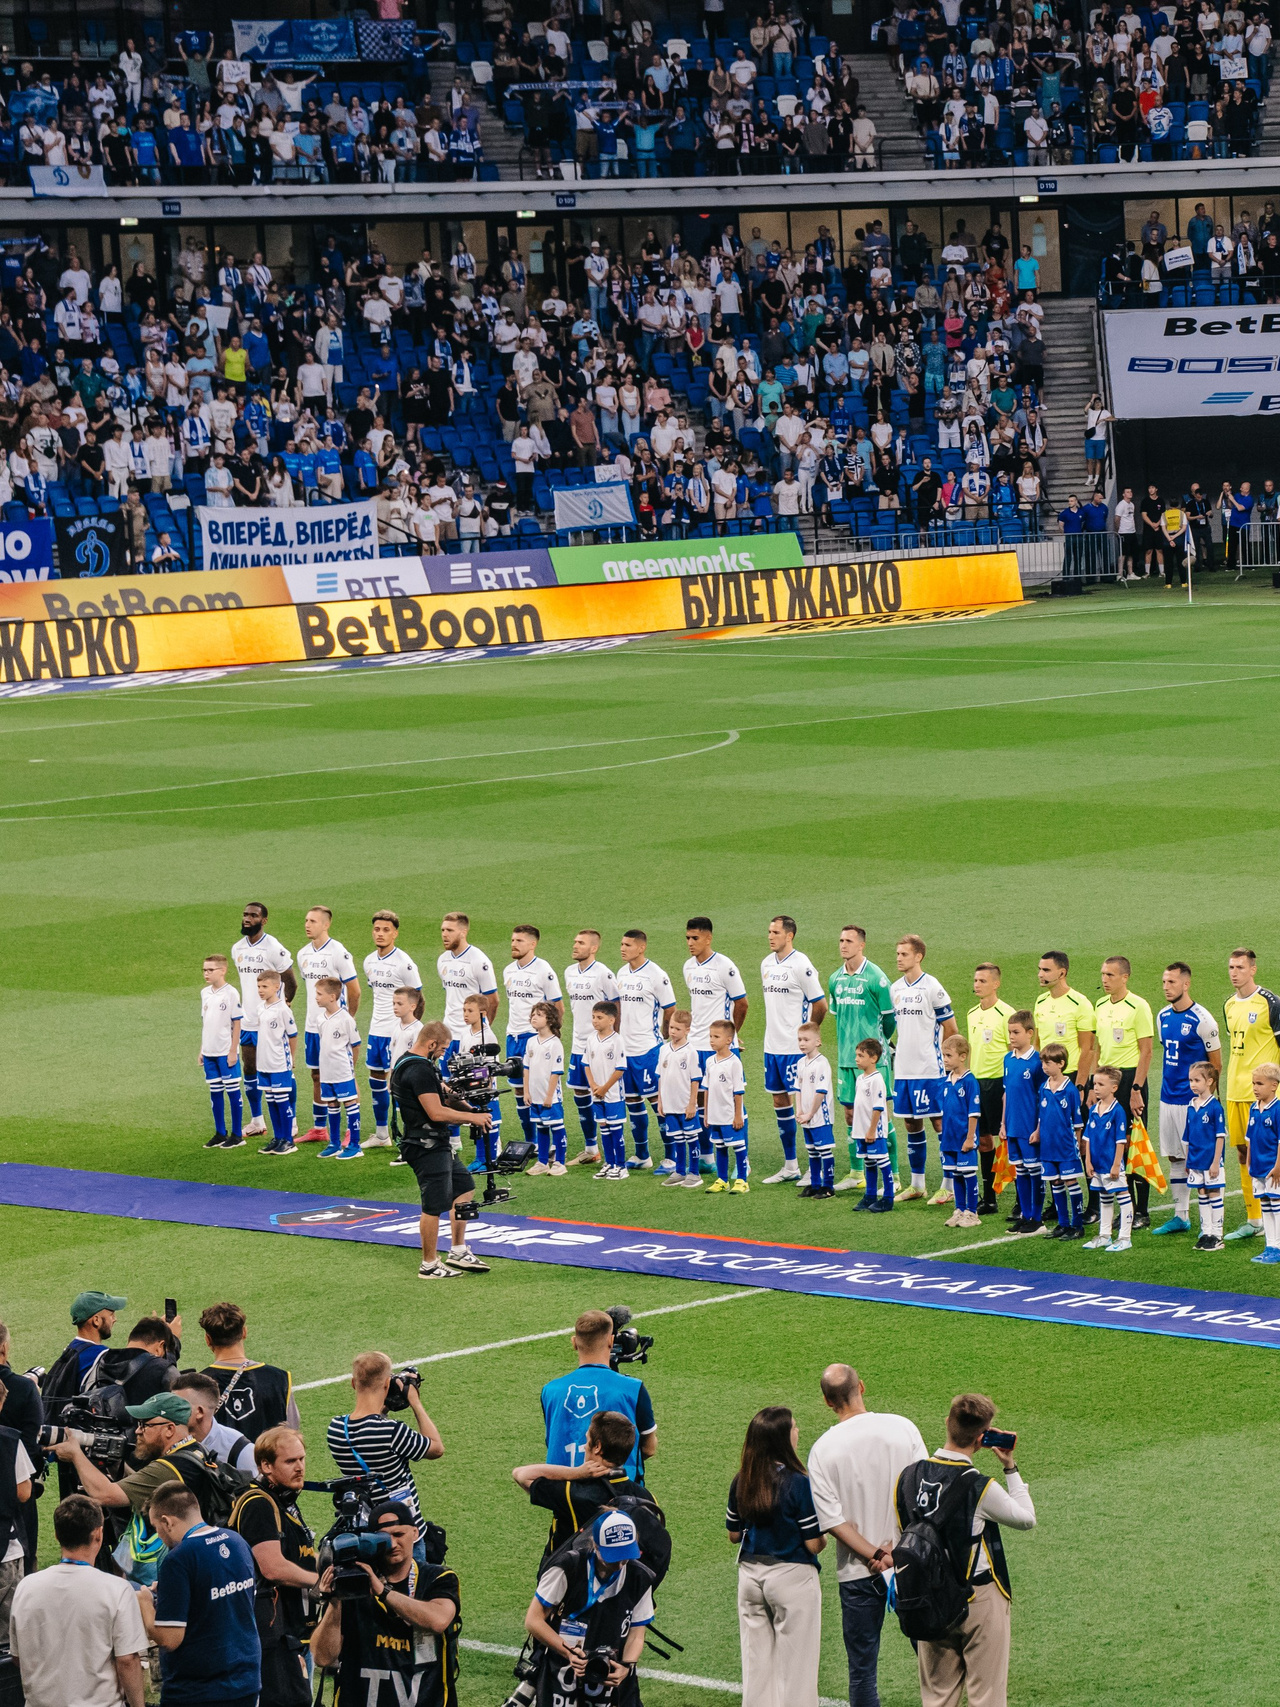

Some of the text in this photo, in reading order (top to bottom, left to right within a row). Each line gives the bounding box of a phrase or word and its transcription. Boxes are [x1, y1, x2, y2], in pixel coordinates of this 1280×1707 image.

[208, 511, 372, 548] ВПЕРЁД, ВПЕРЁД
[477, 565, 538, 590] ВТБ
[602, 545, 754, 582] greenworks
[344, 575, 407, 600] ВТБ
[681, 561, 903, 629] БУДЕТ ЖАРКО
[296, 596, 544, 659] BetBoom
[1205, 1041, 1212, 1049] C
[643, 1068, 652, 1085] 4
[914, 1089, 931, 1107] 74
[601, 1243, 1035, 1298] РОССИЙСКАЯ
[210, 1577, 254, 1601] BetBoom
[360, 1667, 426, 1707] TV
